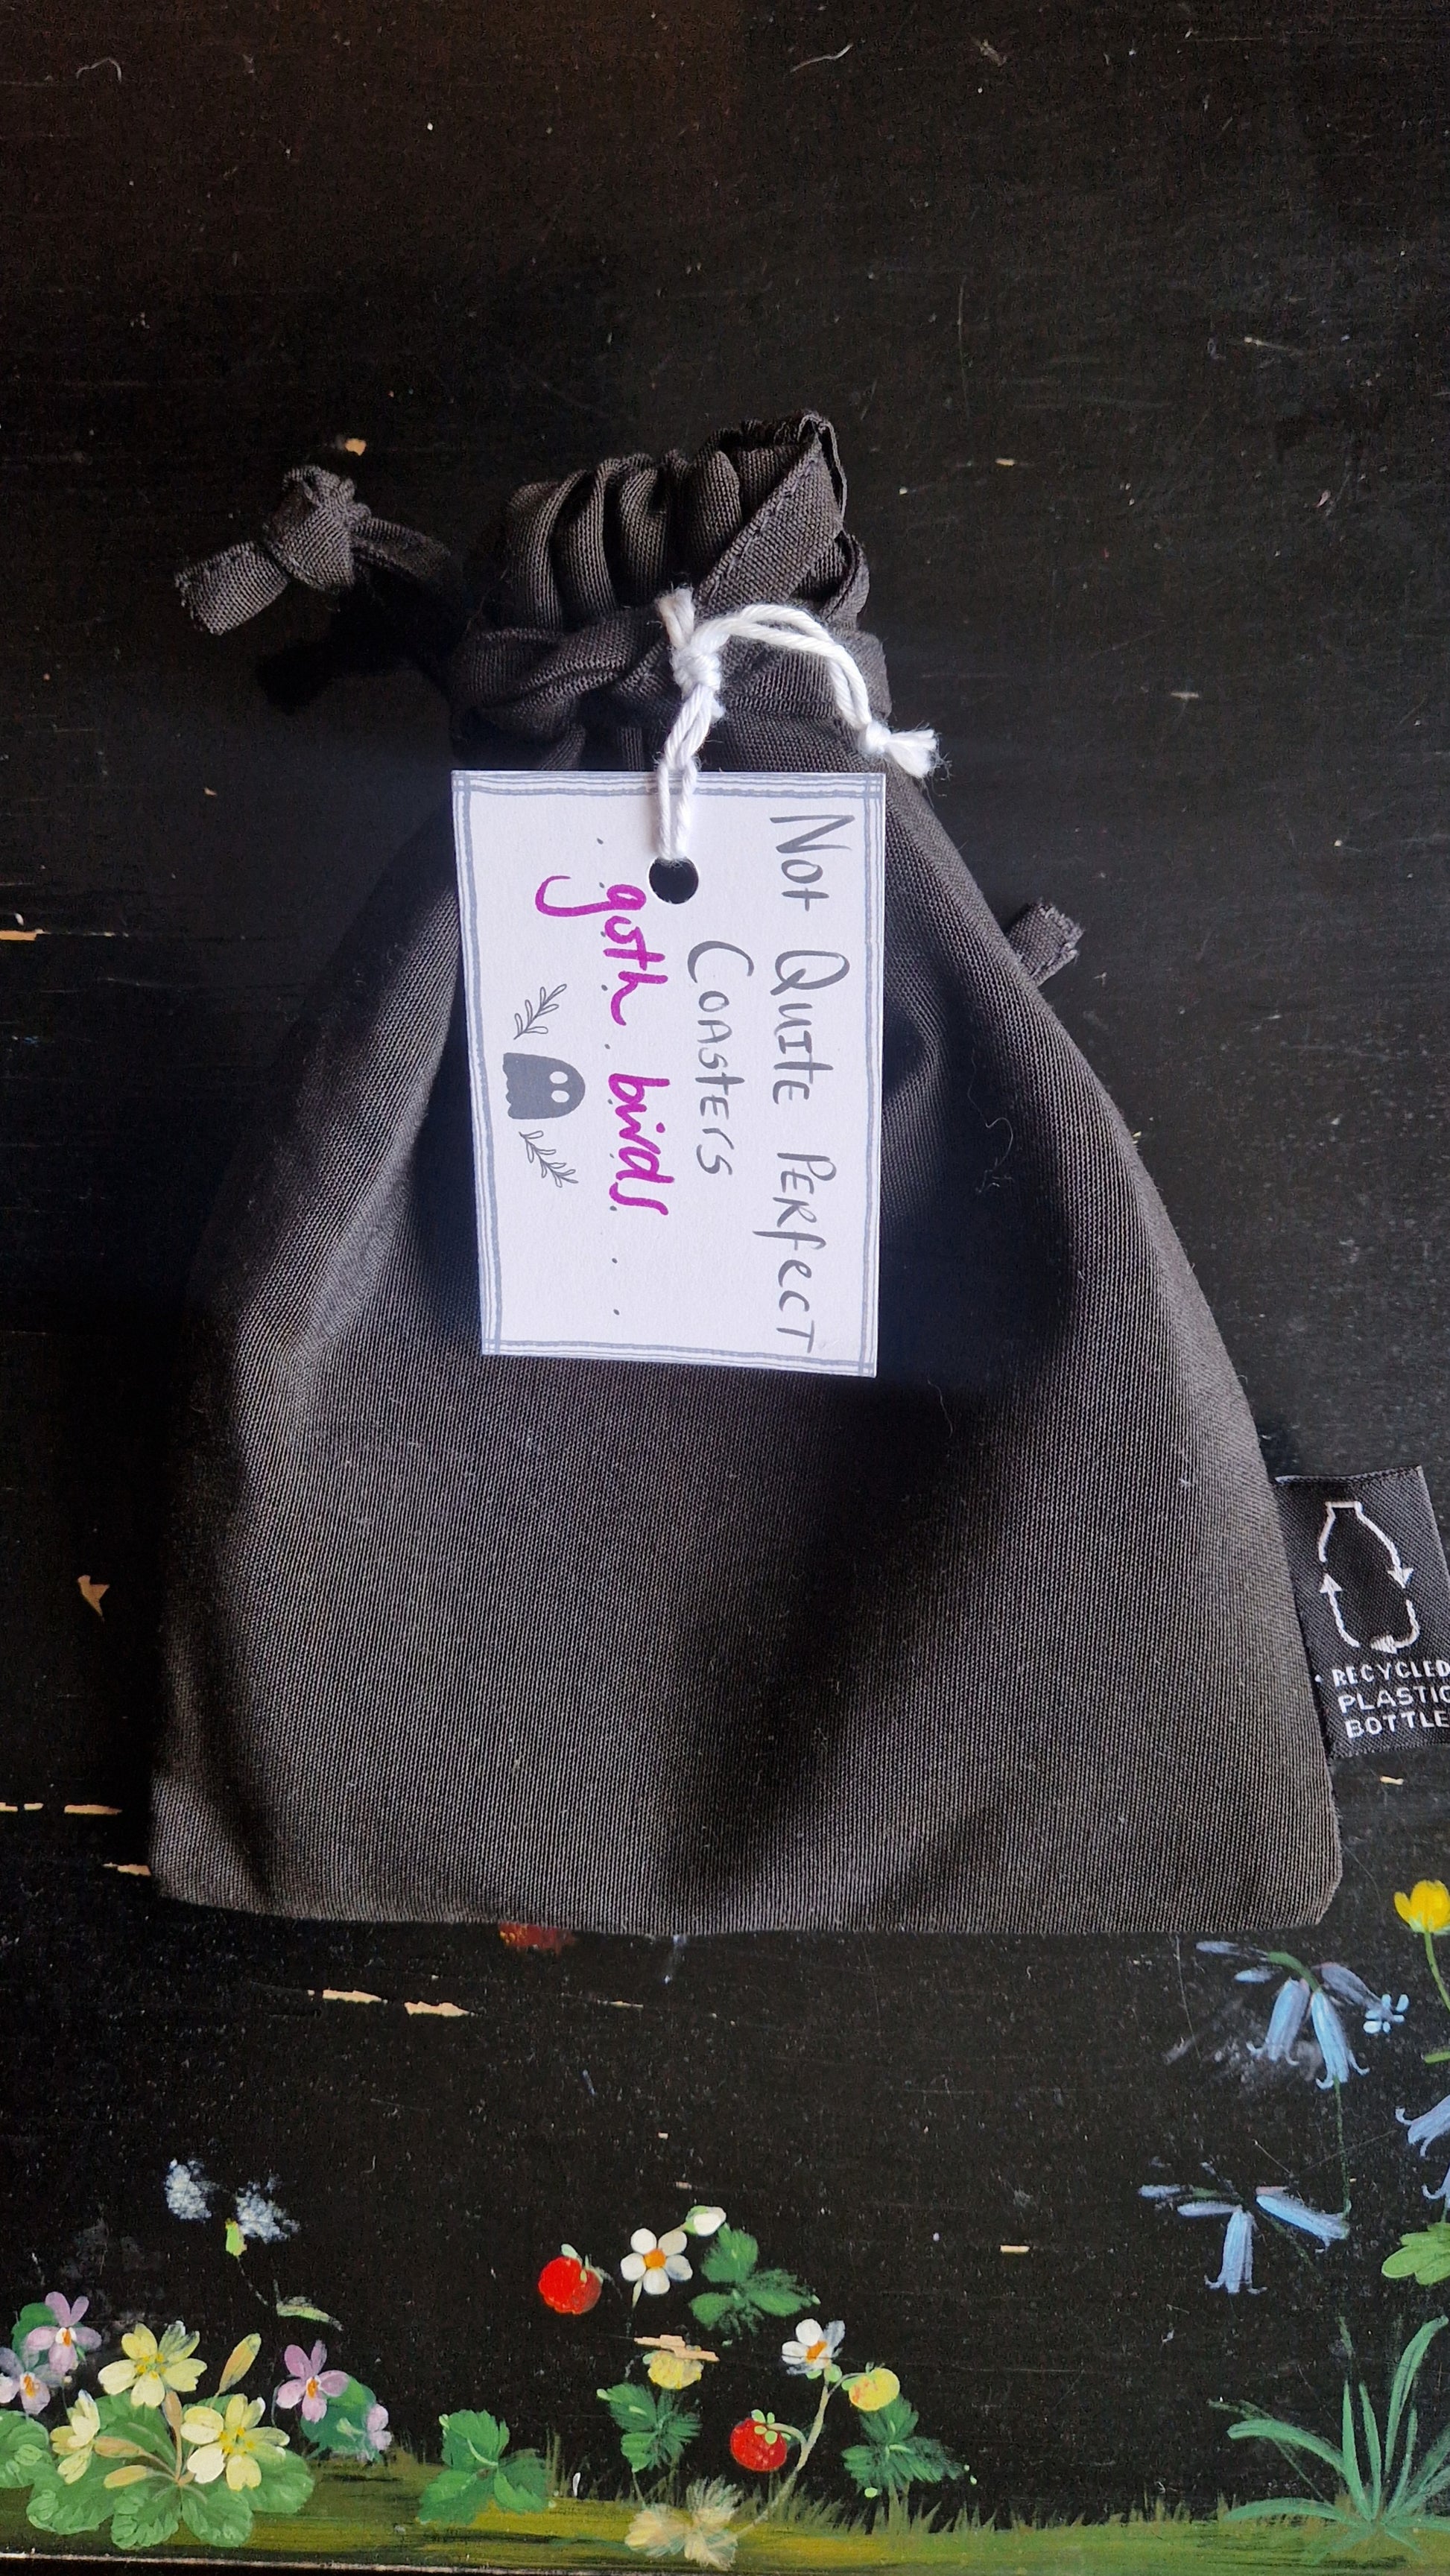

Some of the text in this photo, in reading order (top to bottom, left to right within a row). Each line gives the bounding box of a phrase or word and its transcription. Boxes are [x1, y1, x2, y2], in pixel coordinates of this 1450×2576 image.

[535, 875, 674, 1215] goth birds
[1332, 1659, 1450, 1687] RECYCLED
[1337, 1685, 1450, 1713] PLASTIC
